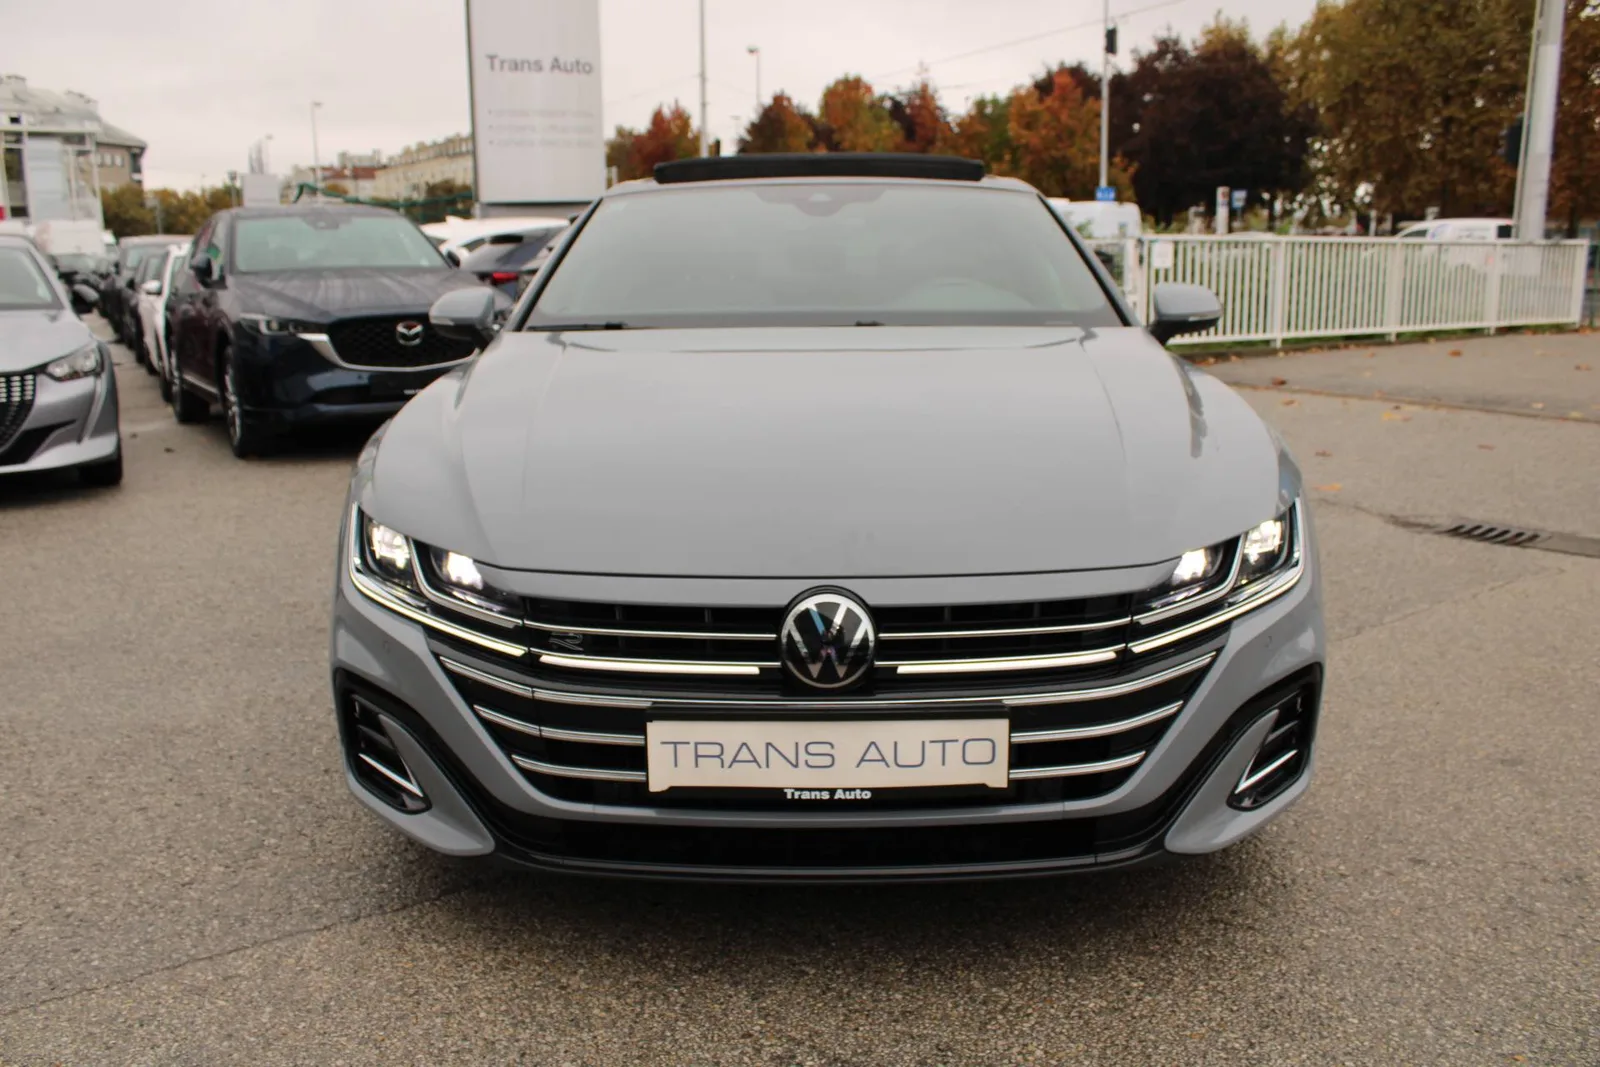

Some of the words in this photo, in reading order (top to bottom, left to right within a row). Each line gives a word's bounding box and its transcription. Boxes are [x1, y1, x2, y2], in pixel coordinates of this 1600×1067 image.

[485, 53, 543, 73] Trans
[550, 56, 593, 75] Auto
[660, 741, 835, 769] TRANS
[855, 738, 996, 769] AUTO
[784, 788, 830, 800] Trans
[834, 789, 872, 800] Auto
